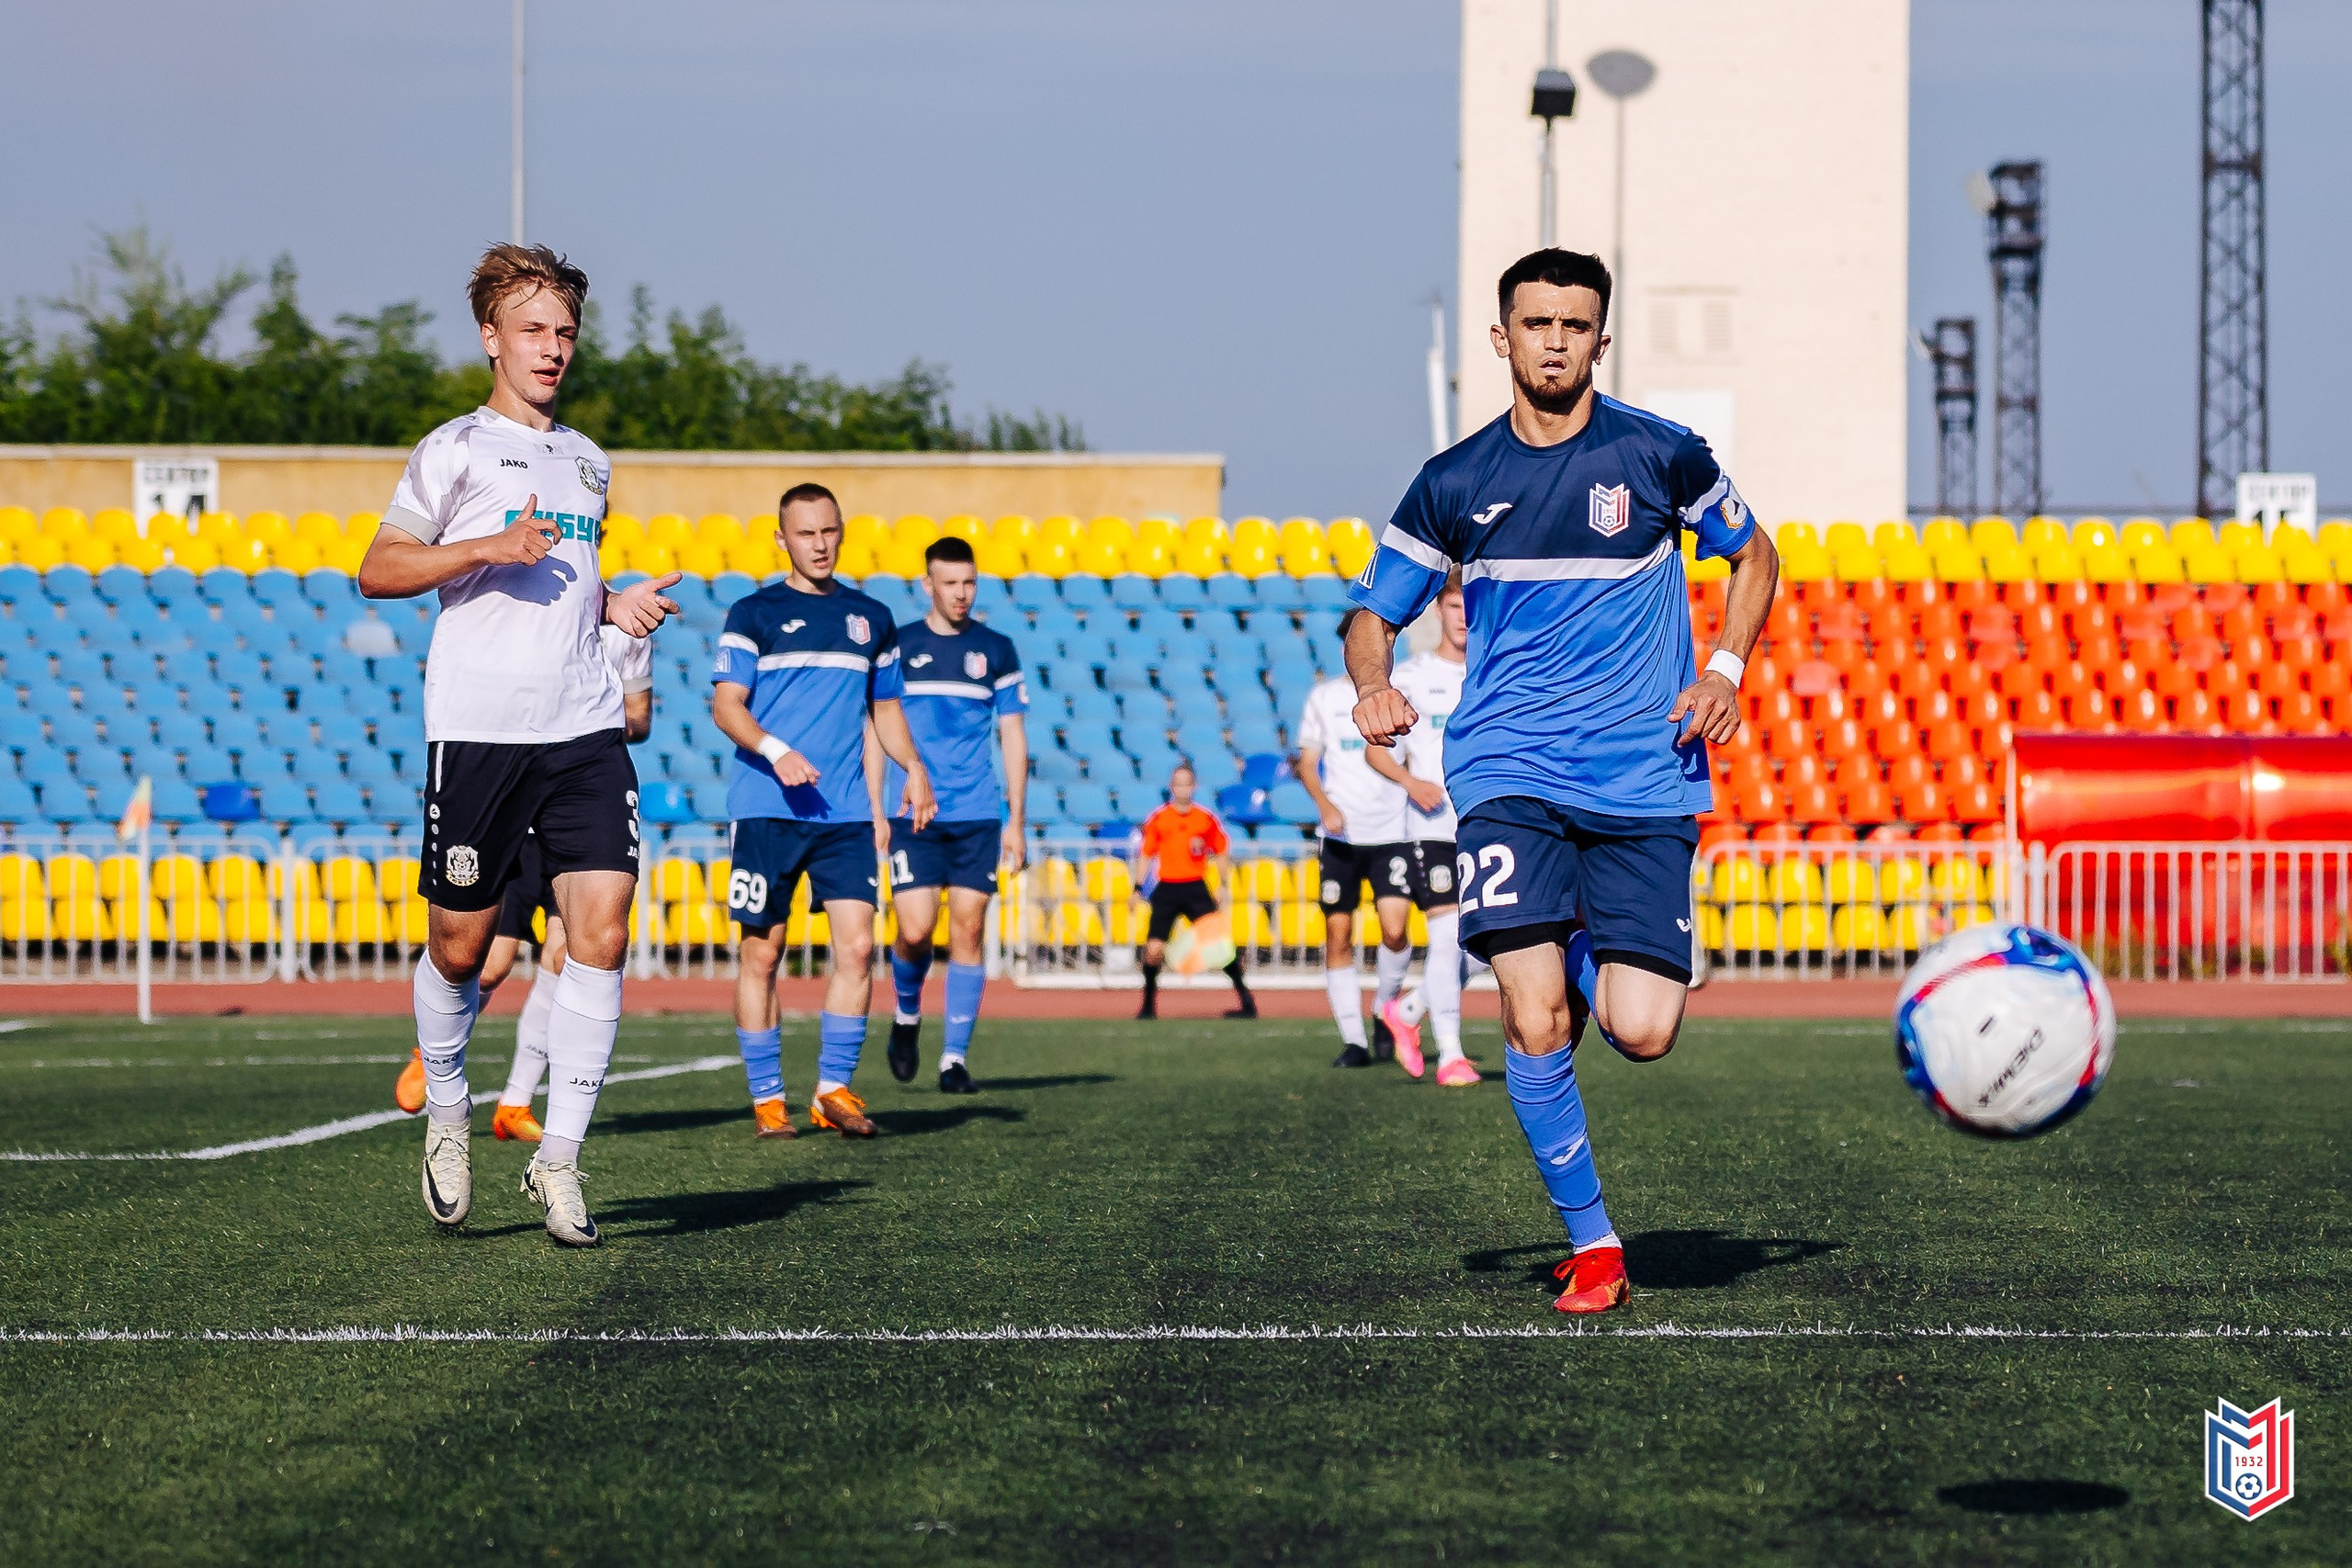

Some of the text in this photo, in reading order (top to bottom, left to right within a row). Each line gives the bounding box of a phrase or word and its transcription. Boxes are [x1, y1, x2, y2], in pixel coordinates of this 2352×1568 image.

[500, 458, 528, 469] JAKO
[1388, 855, 1408, 886] 2
[1456, 843, 1519, 919] 22
[729, 868, 768, 914] 69
